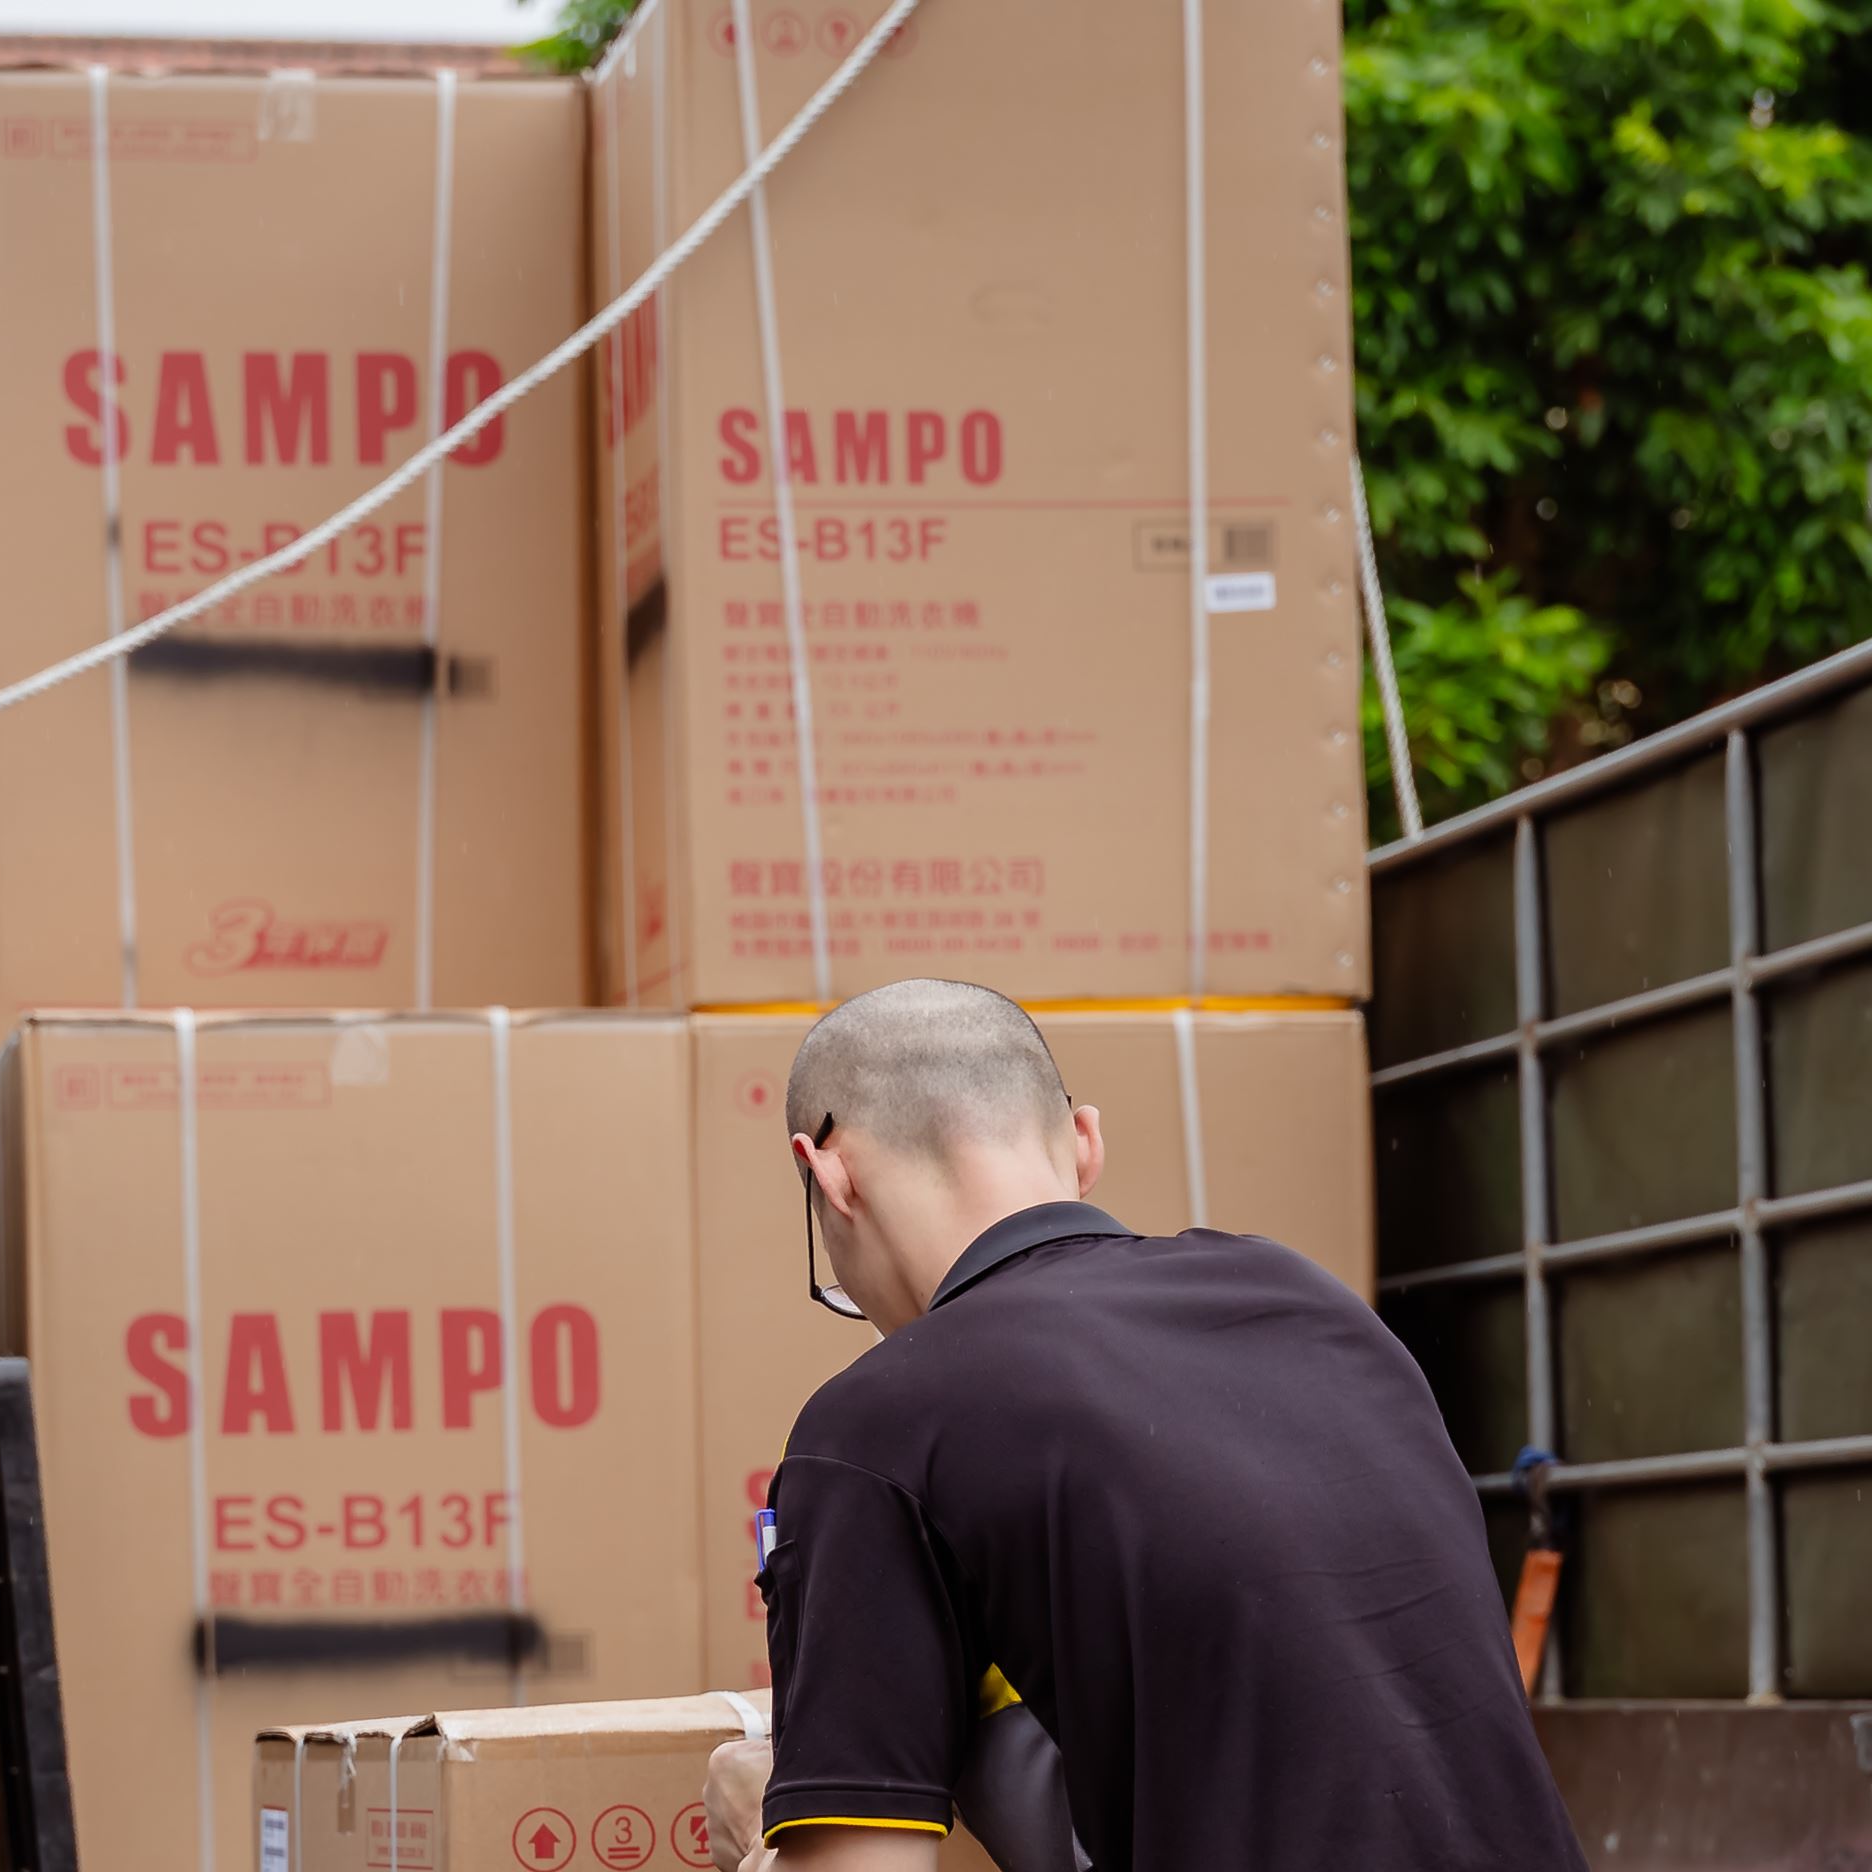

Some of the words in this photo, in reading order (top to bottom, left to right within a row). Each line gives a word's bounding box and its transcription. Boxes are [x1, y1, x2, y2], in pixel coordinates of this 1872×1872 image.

[62, 349, 504, 467] SAMPO
[719, 408, 1003, 486] SAMPO
[719, 516, 948, 562] ES-B13F
[124, 1302, 602, 1440] SAMPO
[212, 1493, 522, 1553] ES-B13F
